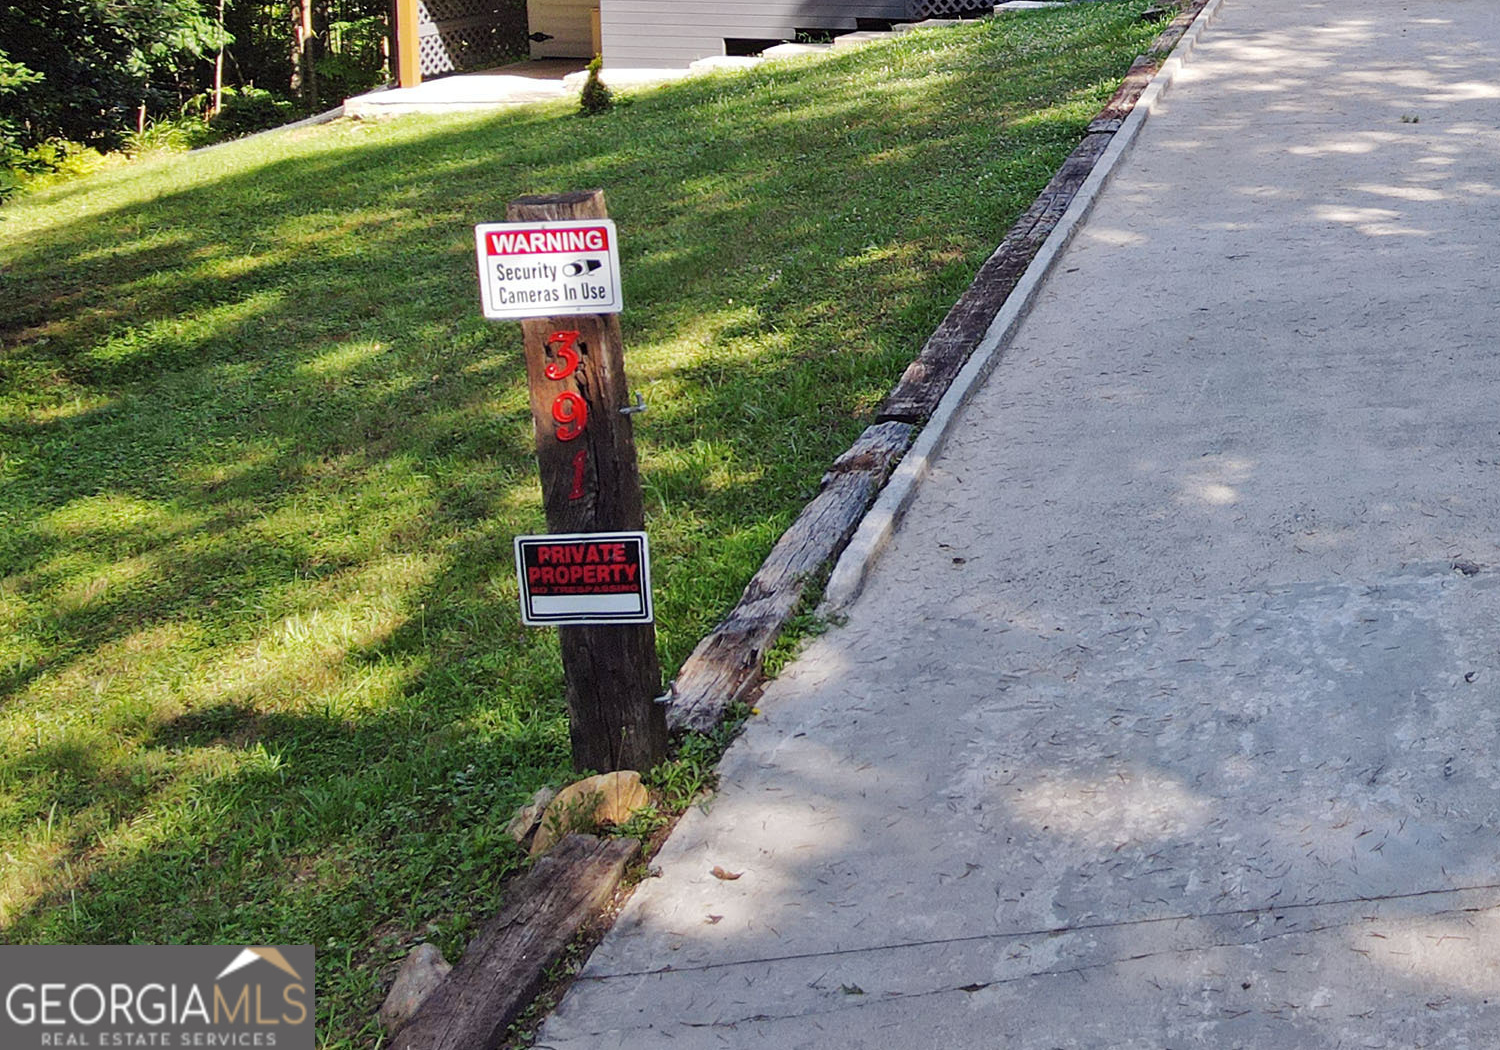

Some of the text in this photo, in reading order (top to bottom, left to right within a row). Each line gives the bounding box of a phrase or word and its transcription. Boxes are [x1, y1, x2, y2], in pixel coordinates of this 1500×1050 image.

[492, 231, 604, 254] WARNING
[497, 262, 557, 282] Security
[499, 282, 606, 304] Cameras In Use
[537, 544, 626, 563] PRIVATE
[528, 564, 637, 584] PROPERTY
